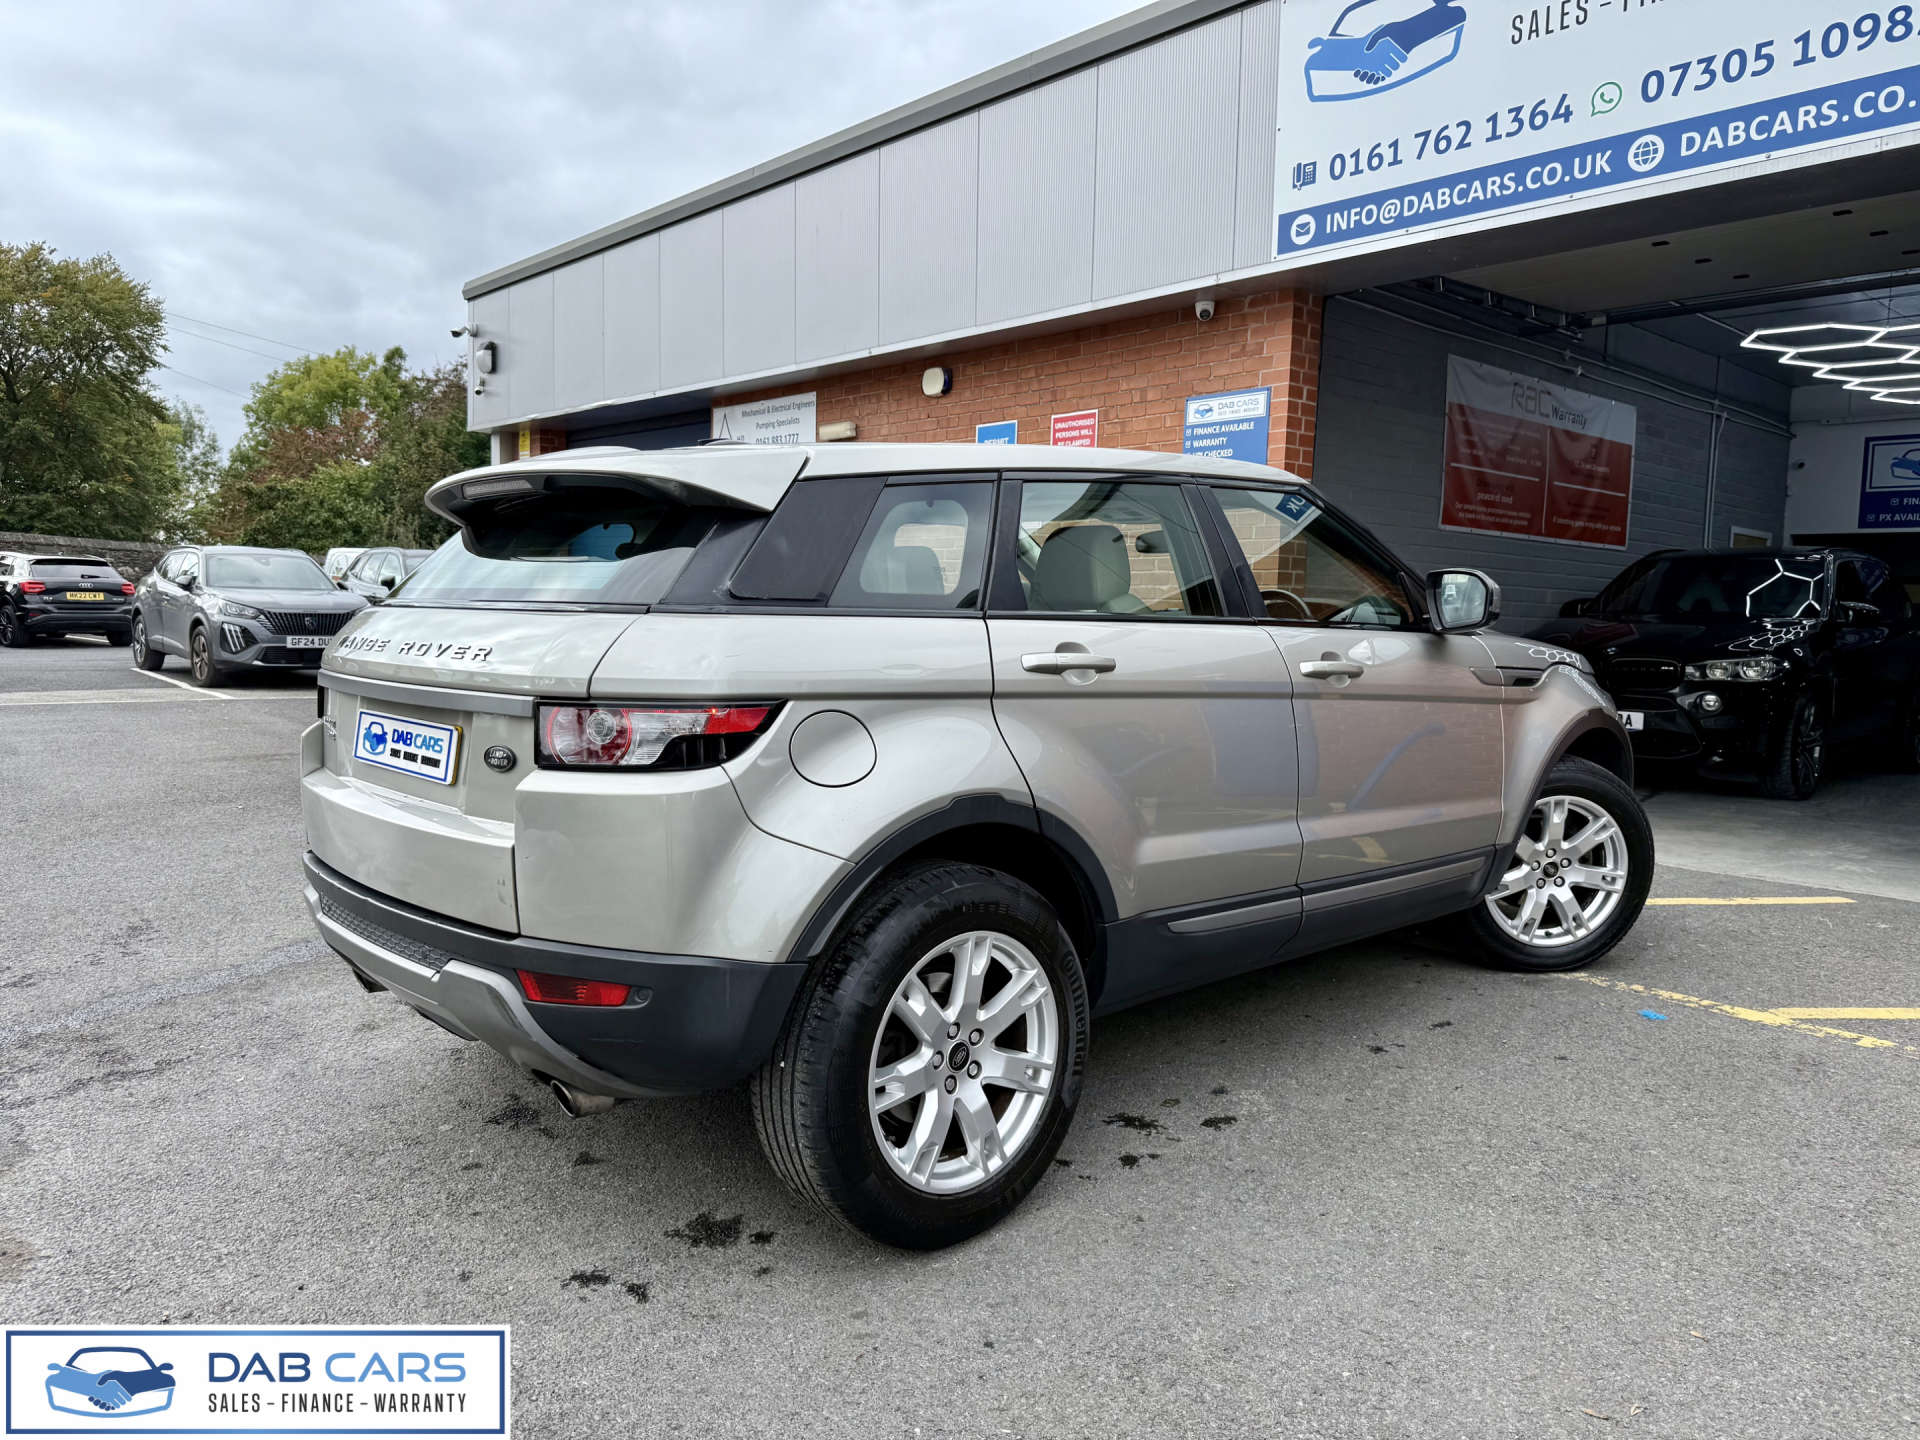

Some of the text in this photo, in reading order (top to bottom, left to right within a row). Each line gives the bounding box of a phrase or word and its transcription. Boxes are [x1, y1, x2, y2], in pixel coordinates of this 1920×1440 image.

[1511, 0, 1588, 45] SALES
[1640, 5, 1920, 103] 07305 1098
[1680, 85, 1917, 157] DABCARS.CO.
[1329, 93, 1573, 181] 0161 762 1364
[1325, 149, 1613, 234] INFO@DABCARS.CO.UK
[1193, 421, 1255, 436] FINANCE AVAILABLE
[1192, 437, 1228, 449] WARRANTY
[1903, 497, 1920, 505] FIN
[291, 637, 333, 647] GF24 DU
[398, 641, 494, 662] ROVER
[391, 728, 444, 754] DAB CARS
